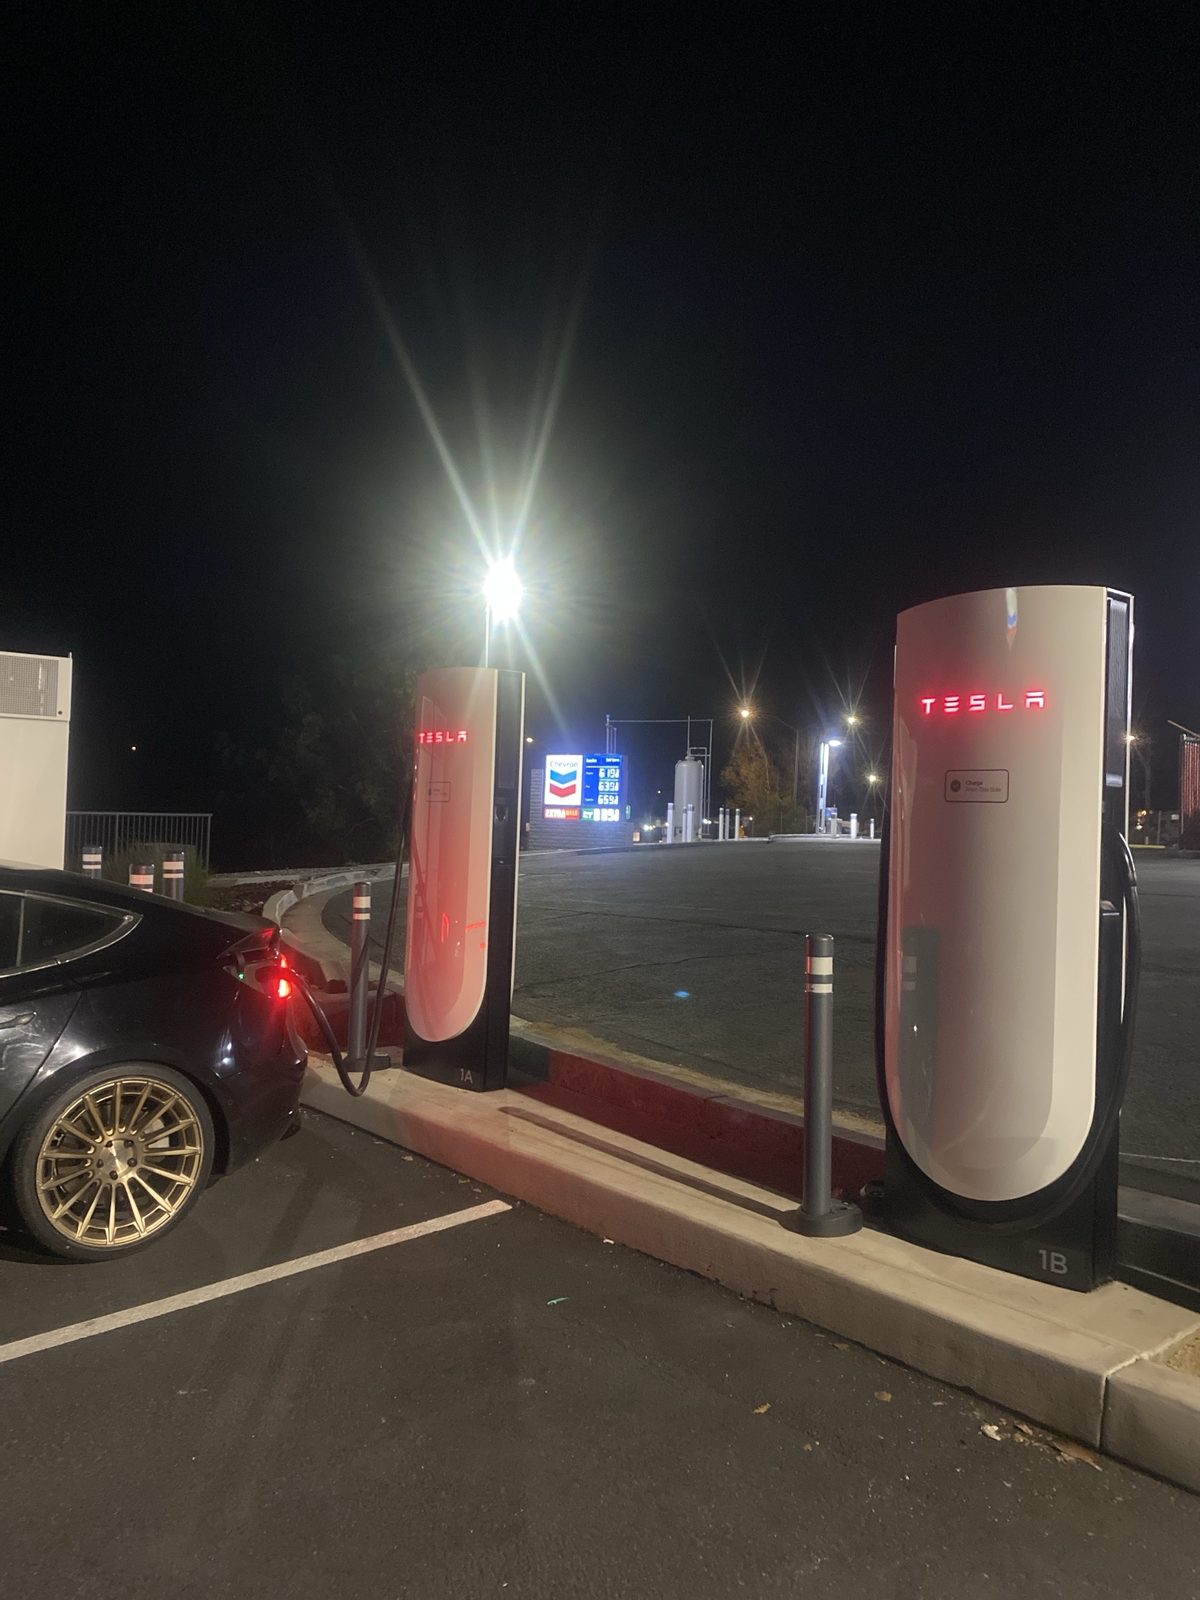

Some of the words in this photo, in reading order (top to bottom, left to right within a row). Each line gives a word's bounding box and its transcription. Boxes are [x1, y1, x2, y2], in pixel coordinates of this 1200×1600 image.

[921, 691, 1045, 715] TESLA
[419, 730, 467, 744] TESLA
[460, 1068, 473, 1084] 1A
[1038, 1249, 1068, 1275] 1B
